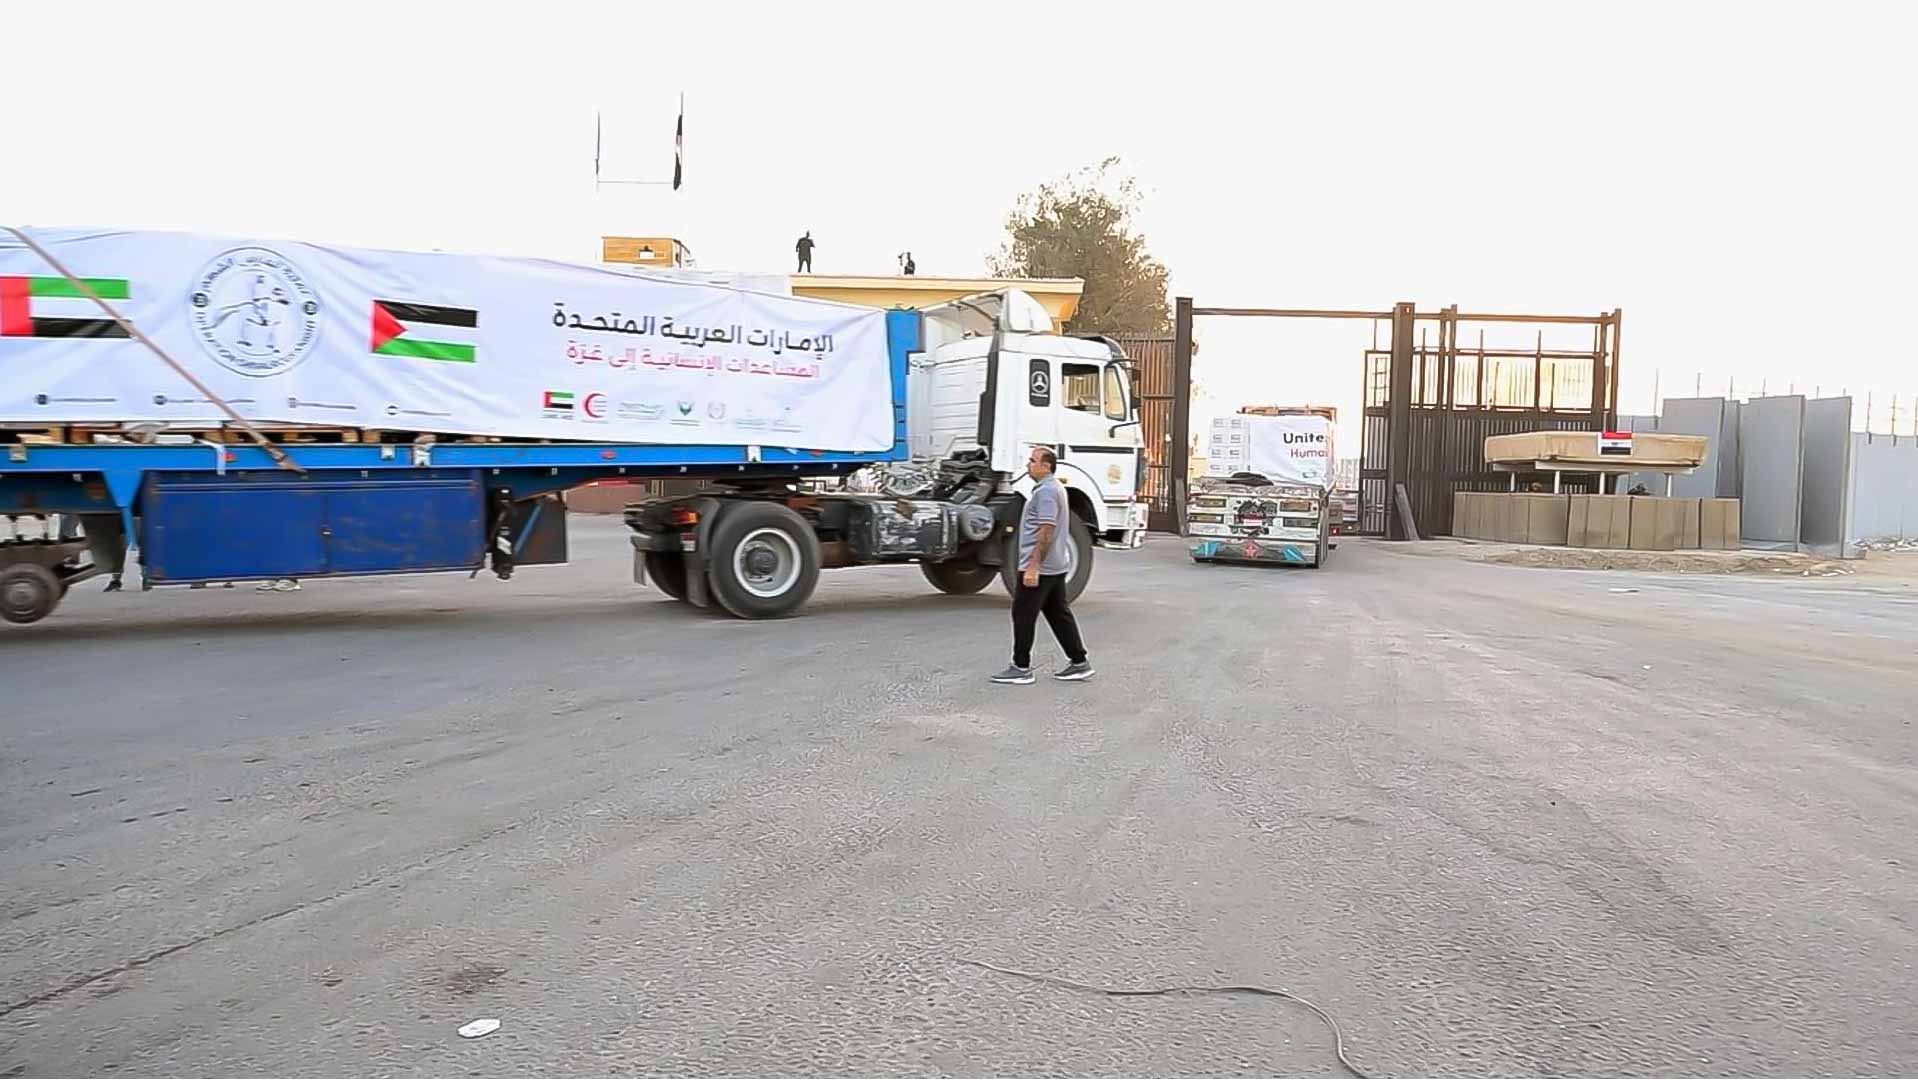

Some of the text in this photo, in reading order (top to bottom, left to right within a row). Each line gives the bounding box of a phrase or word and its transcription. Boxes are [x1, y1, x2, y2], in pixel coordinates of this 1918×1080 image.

[553, 302, 833, 361] الإمارات العربية المتحدة
[727, 358, 820, 378] المساعدات
[1283, 432, 1328, 444] Unite
